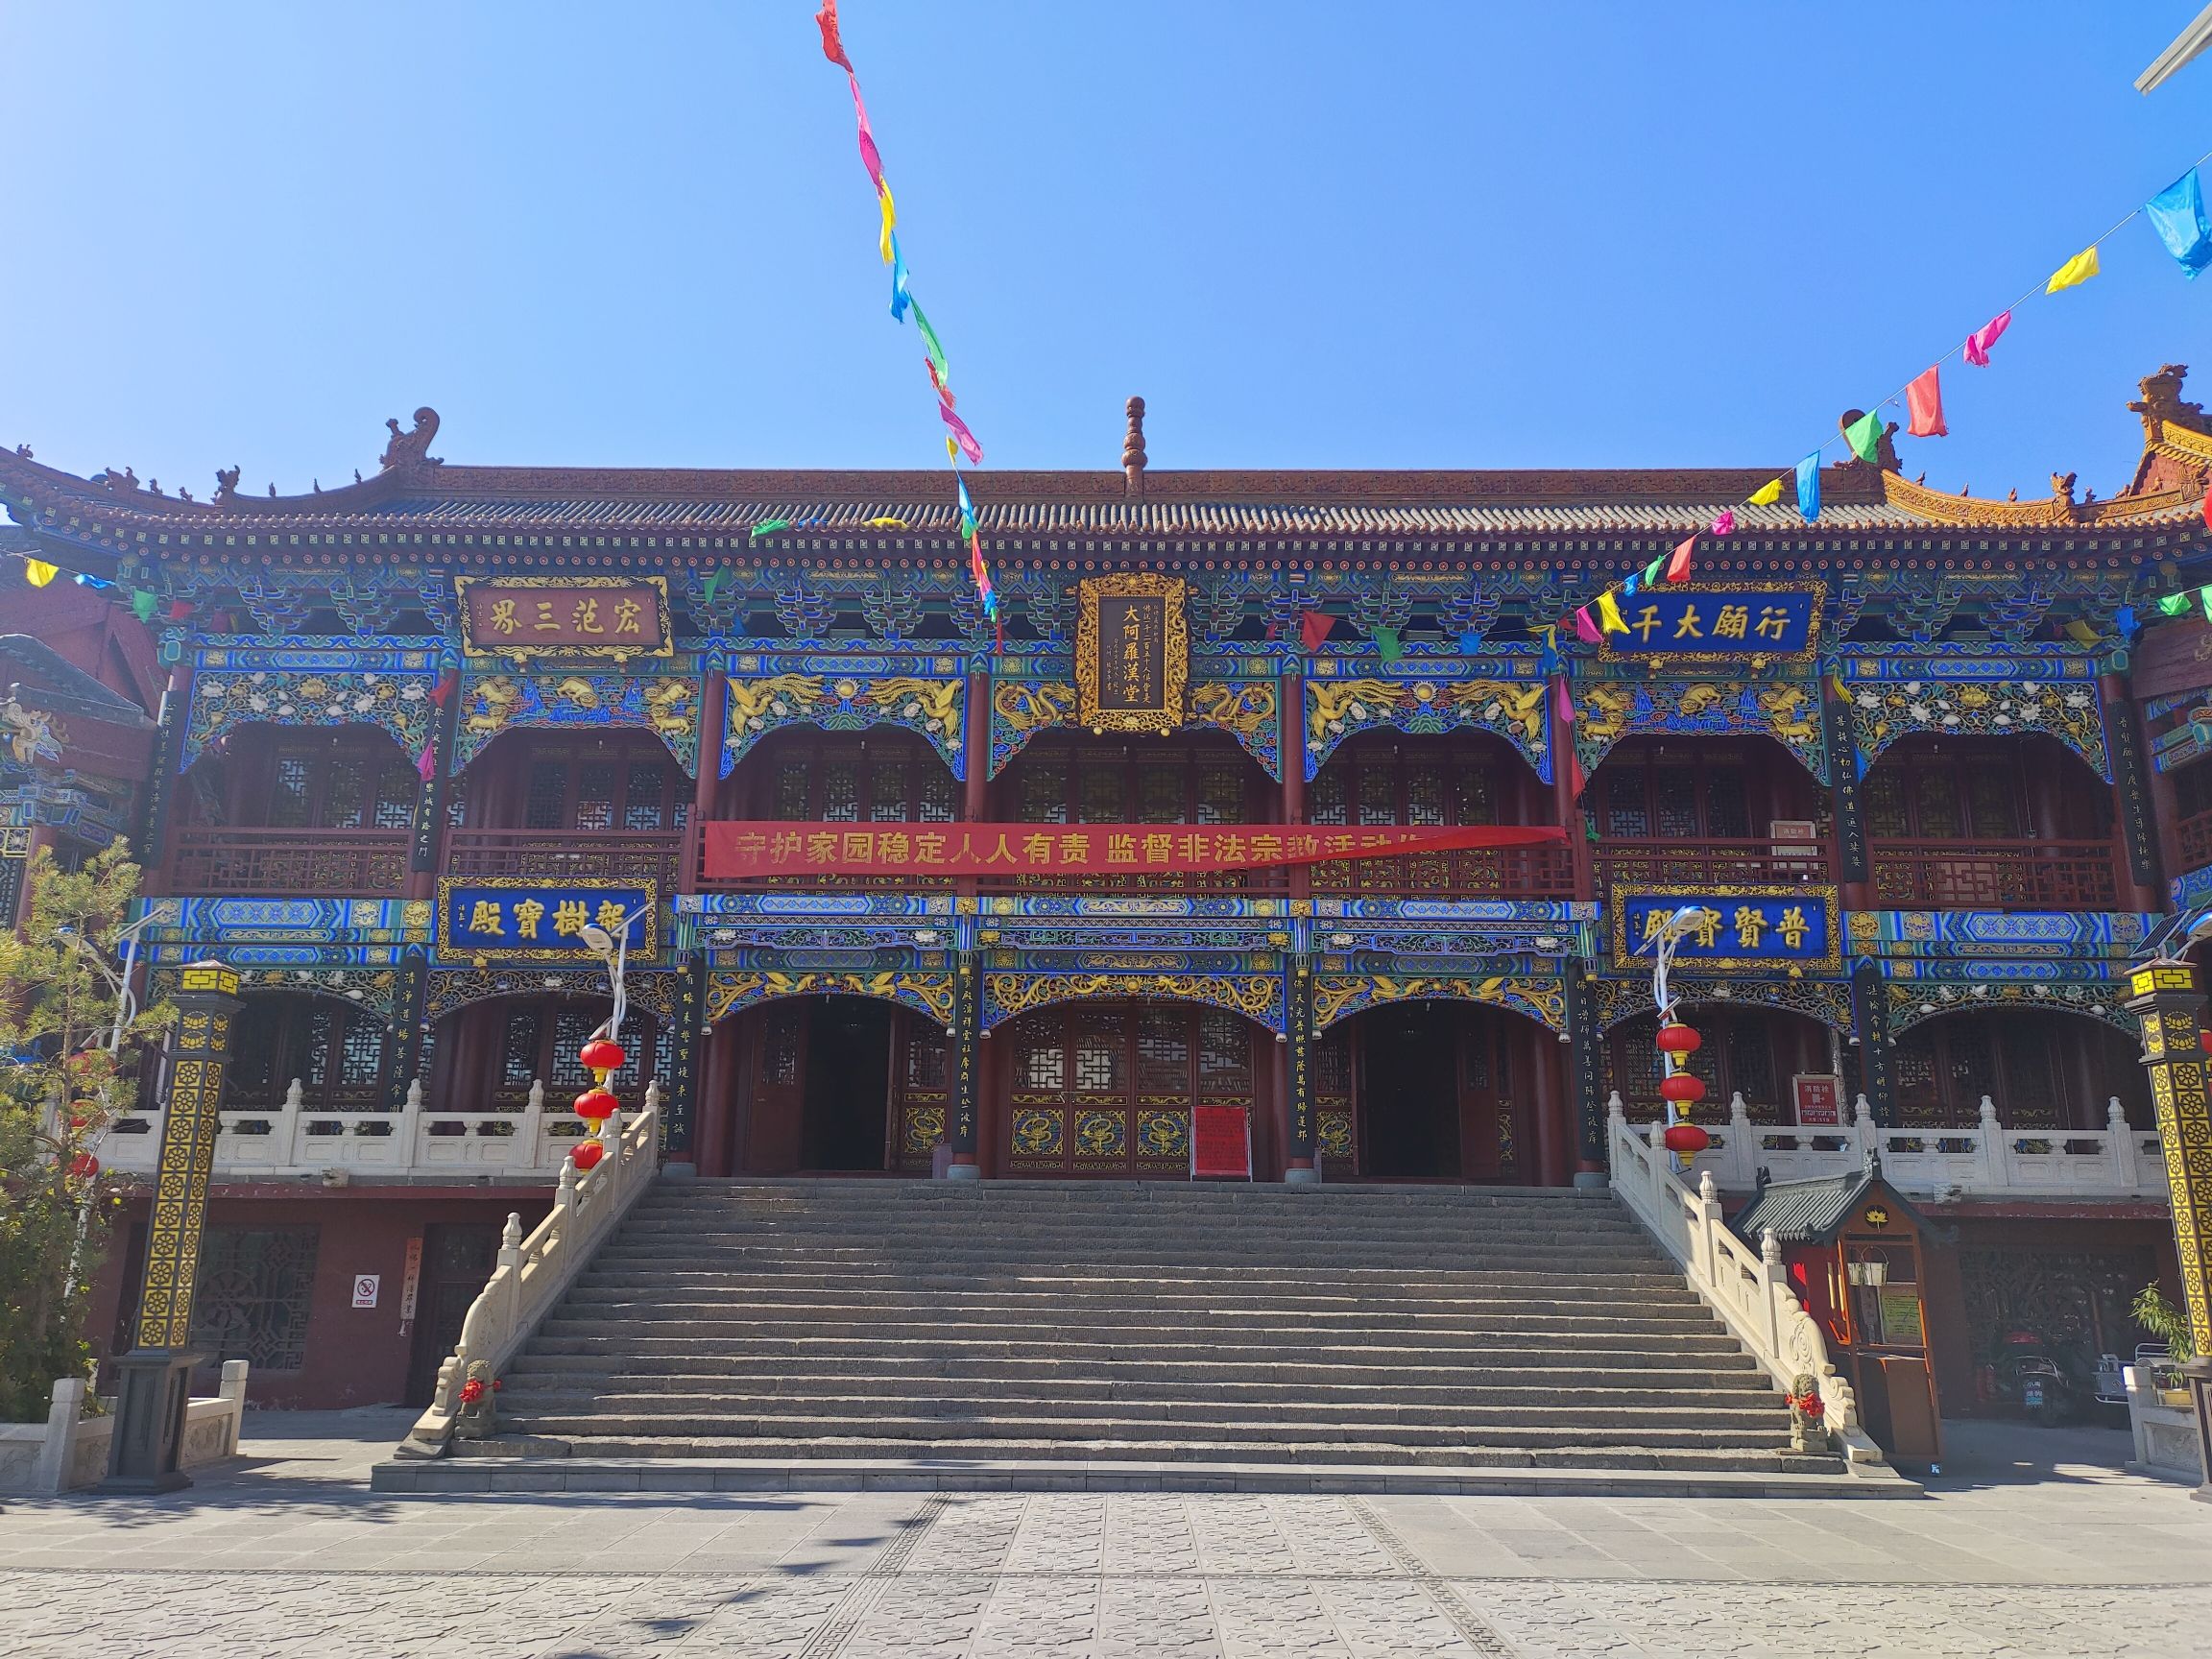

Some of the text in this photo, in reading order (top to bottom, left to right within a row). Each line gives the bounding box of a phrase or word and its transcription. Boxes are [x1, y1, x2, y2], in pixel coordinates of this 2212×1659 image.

[1122, 605, 1141, 703] 大阿羅漢堂
[733, 831, 1091, 864] 守护家园稳定人人有责
